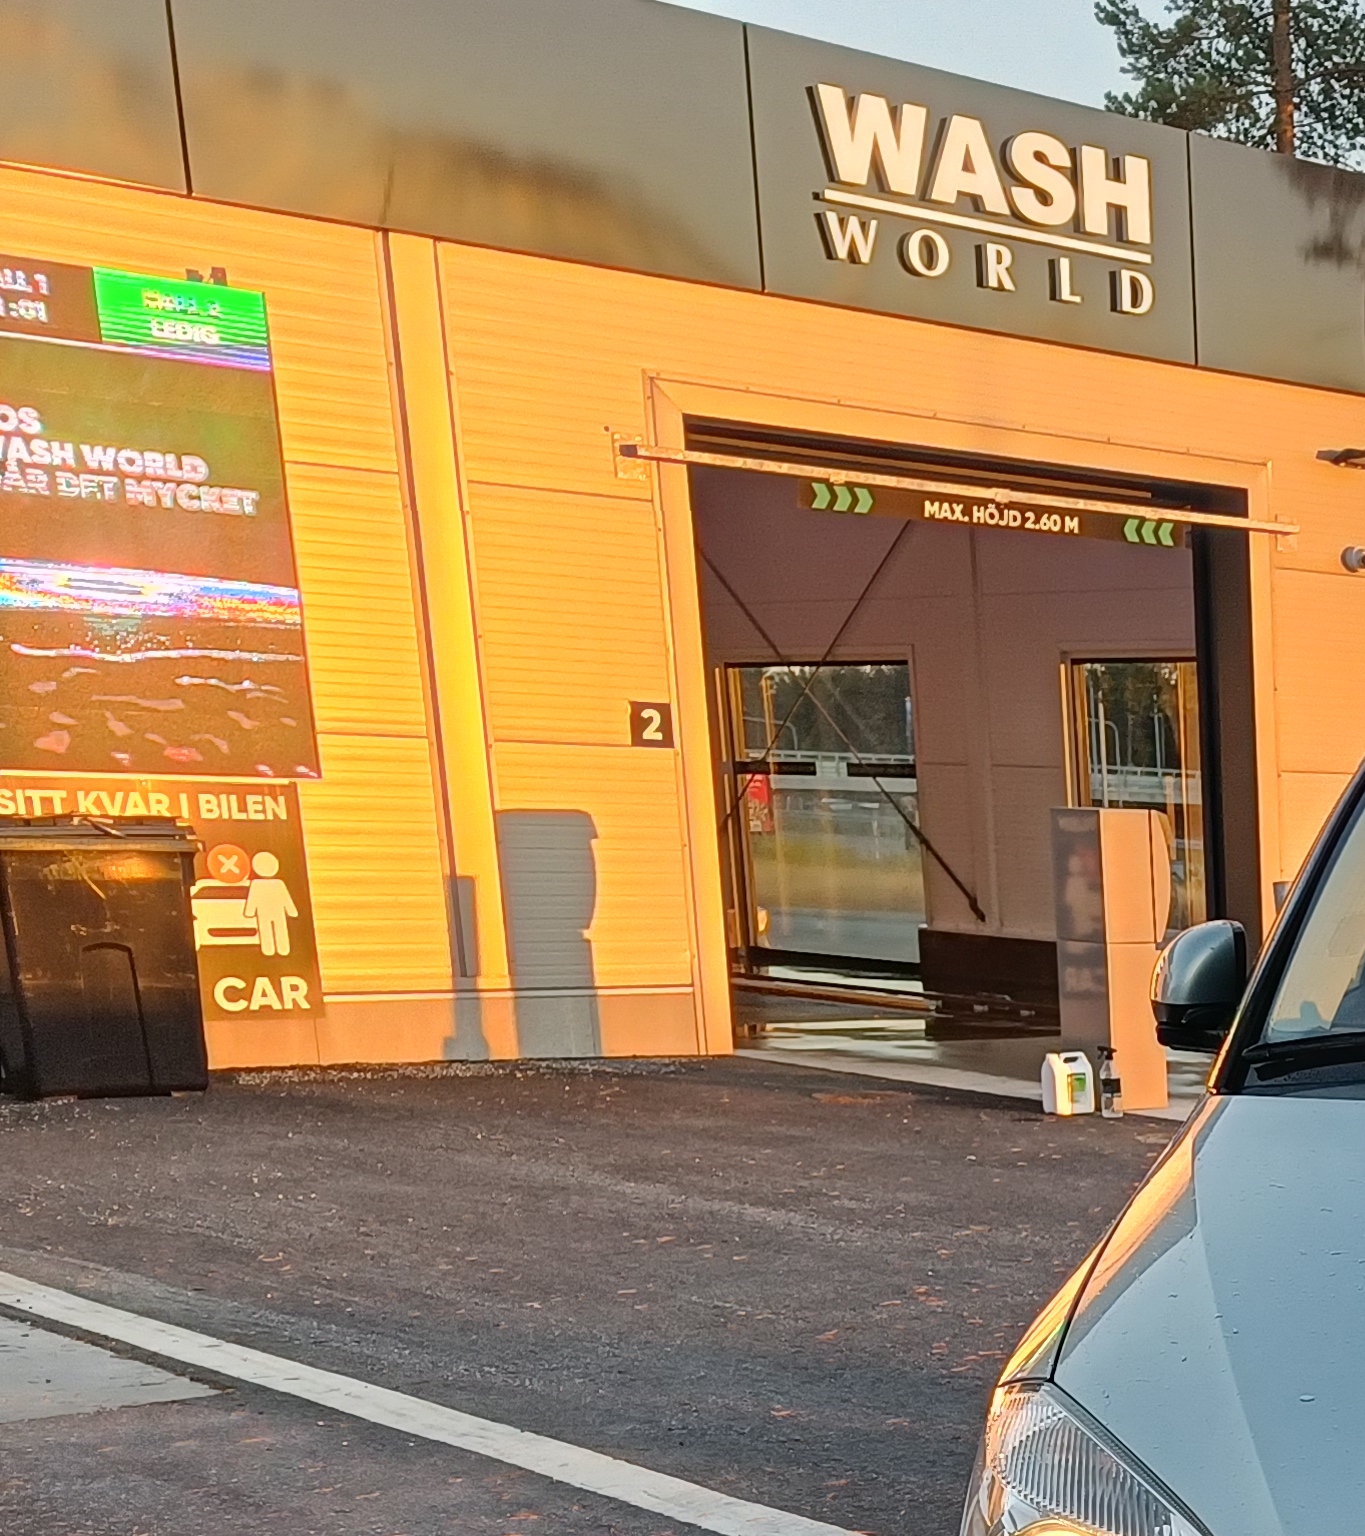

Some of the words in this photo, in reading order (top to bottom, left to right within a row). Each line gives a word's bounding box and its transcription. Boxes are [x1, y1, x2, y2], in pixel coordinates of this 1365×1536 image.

[807, 83, 1152, 244] WASH
[815, 209, 1155, 315] WORLD
[0, 435, 76, 468] ASH
[79, 444, 209, 482] WORLD
[124, 478, 259, 516] MYCKET
[924, 500, 969, 522] MAX.
[973, 503, 1021, 527] HÖJD
[1024, 511, 1061, 532] 2.60
[1064, 515, 1079, 534] M
[640, 708, 663, 740] 2
[0, 788, 67, 815] SITT
[76, 790, 171, 817] KVAR
[179, 793, 189, 818] I
[198, 793, 287, 820] BILEN
[214, 976, 311, 1011] CAR
